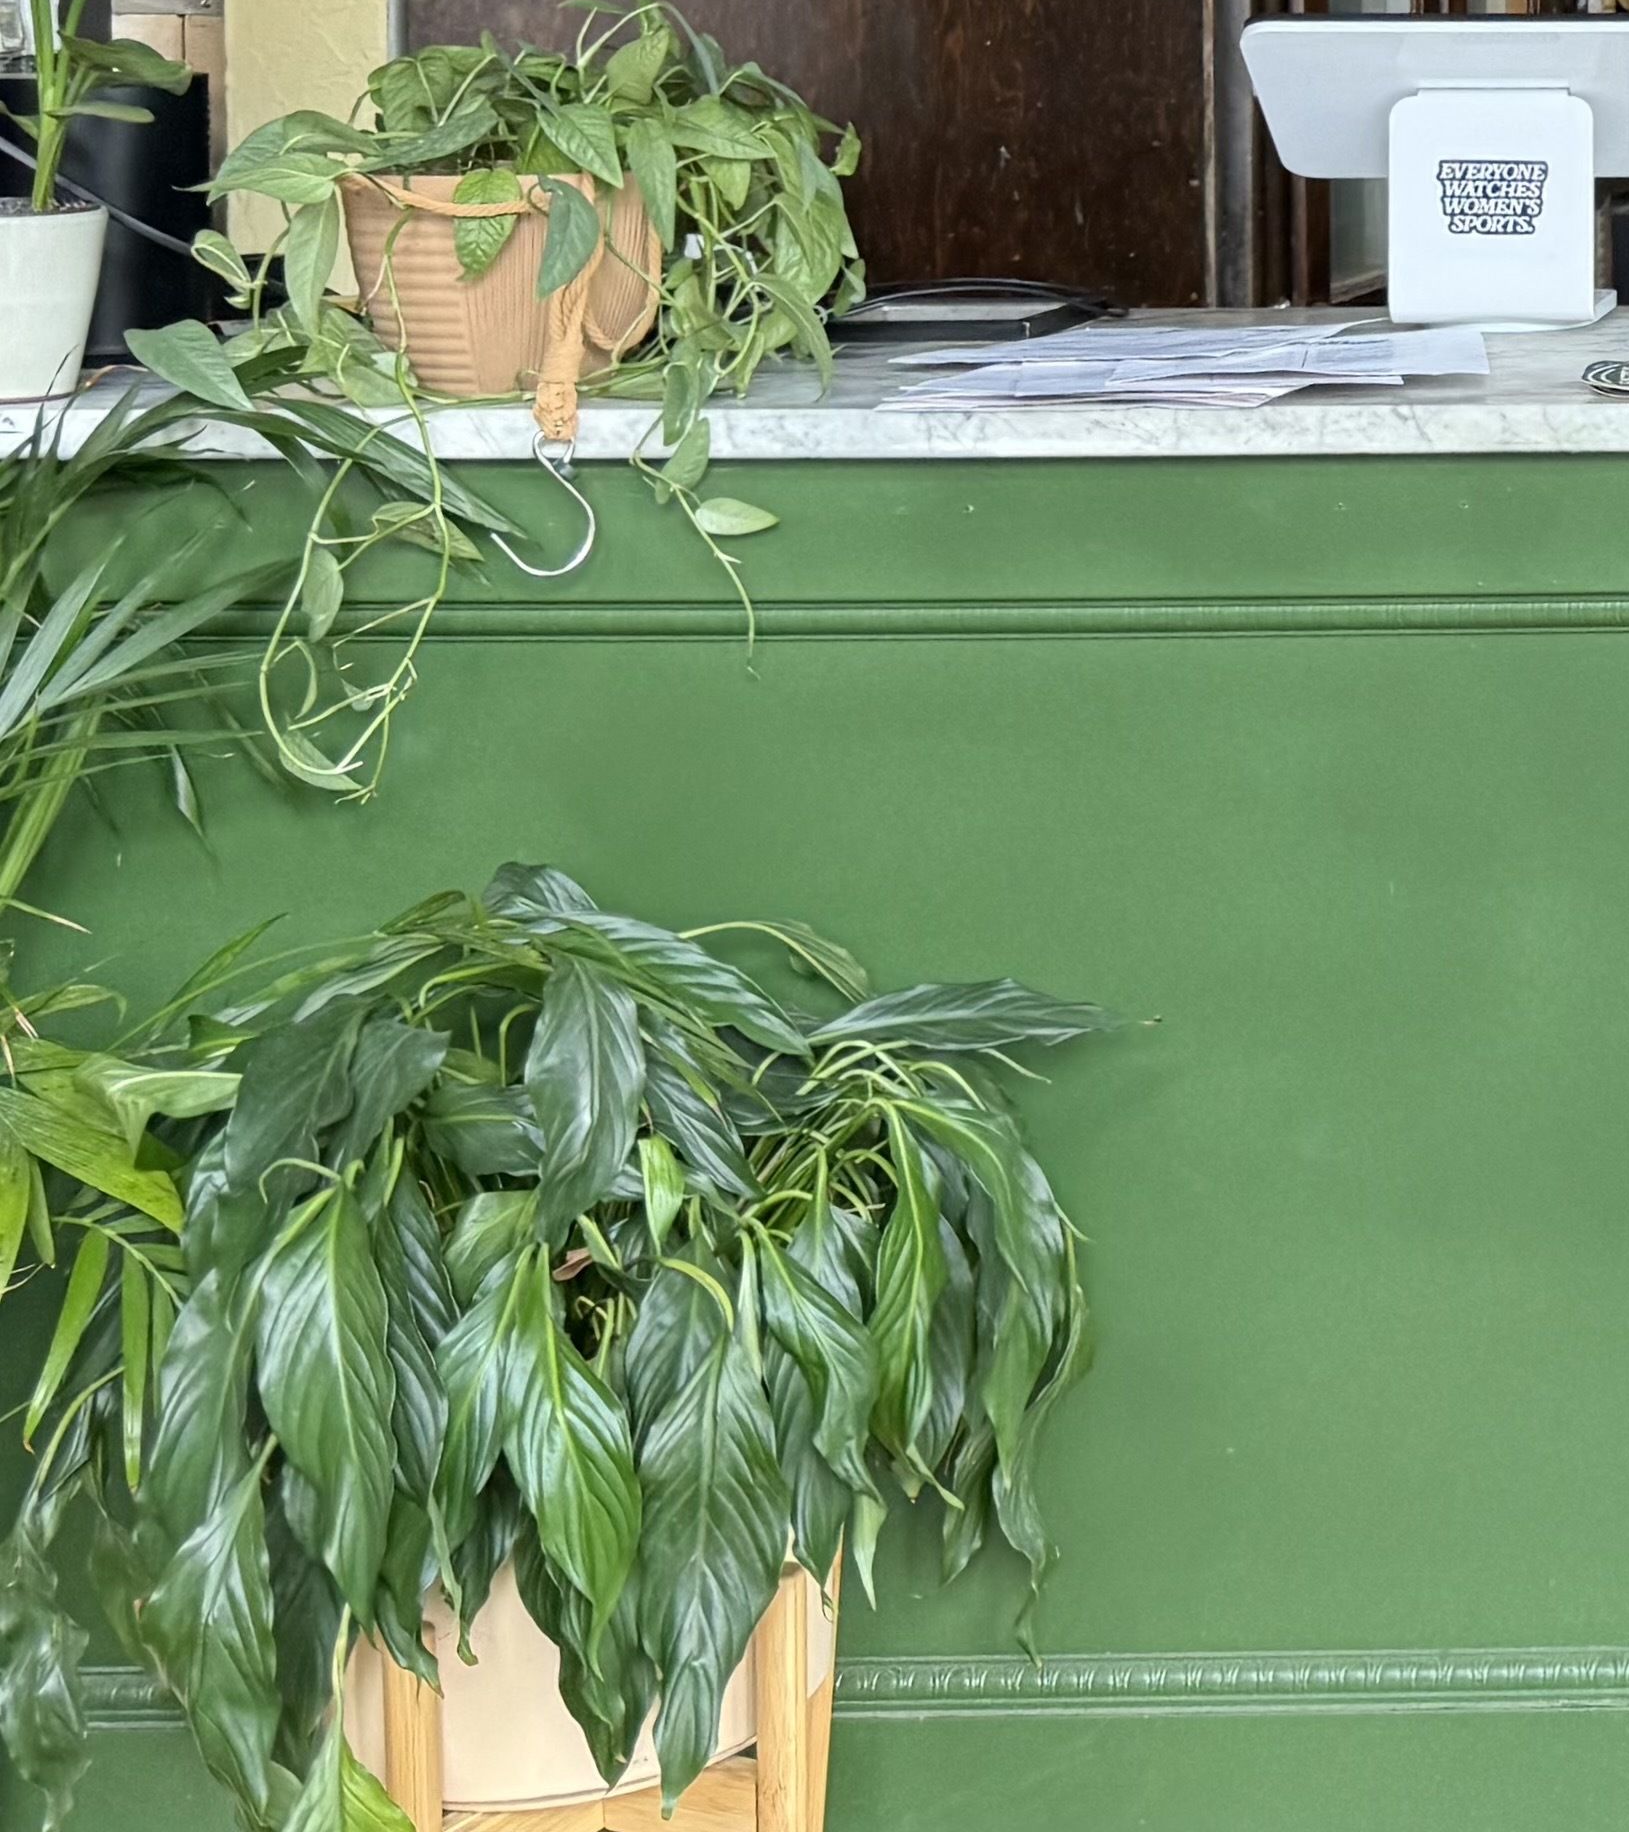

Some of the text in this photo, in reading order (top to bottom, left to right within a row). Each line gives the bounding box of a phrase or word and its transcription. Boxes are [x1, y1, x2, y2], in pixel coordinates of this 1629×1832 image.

[1440, 163, 1546, 180] EVERYONE
[1443, 180, 1541, 197] WATCHES
[1443, 197, 1541, 215] WOMEN'S
[1449, 215, 1534, 233] SPORTS.
